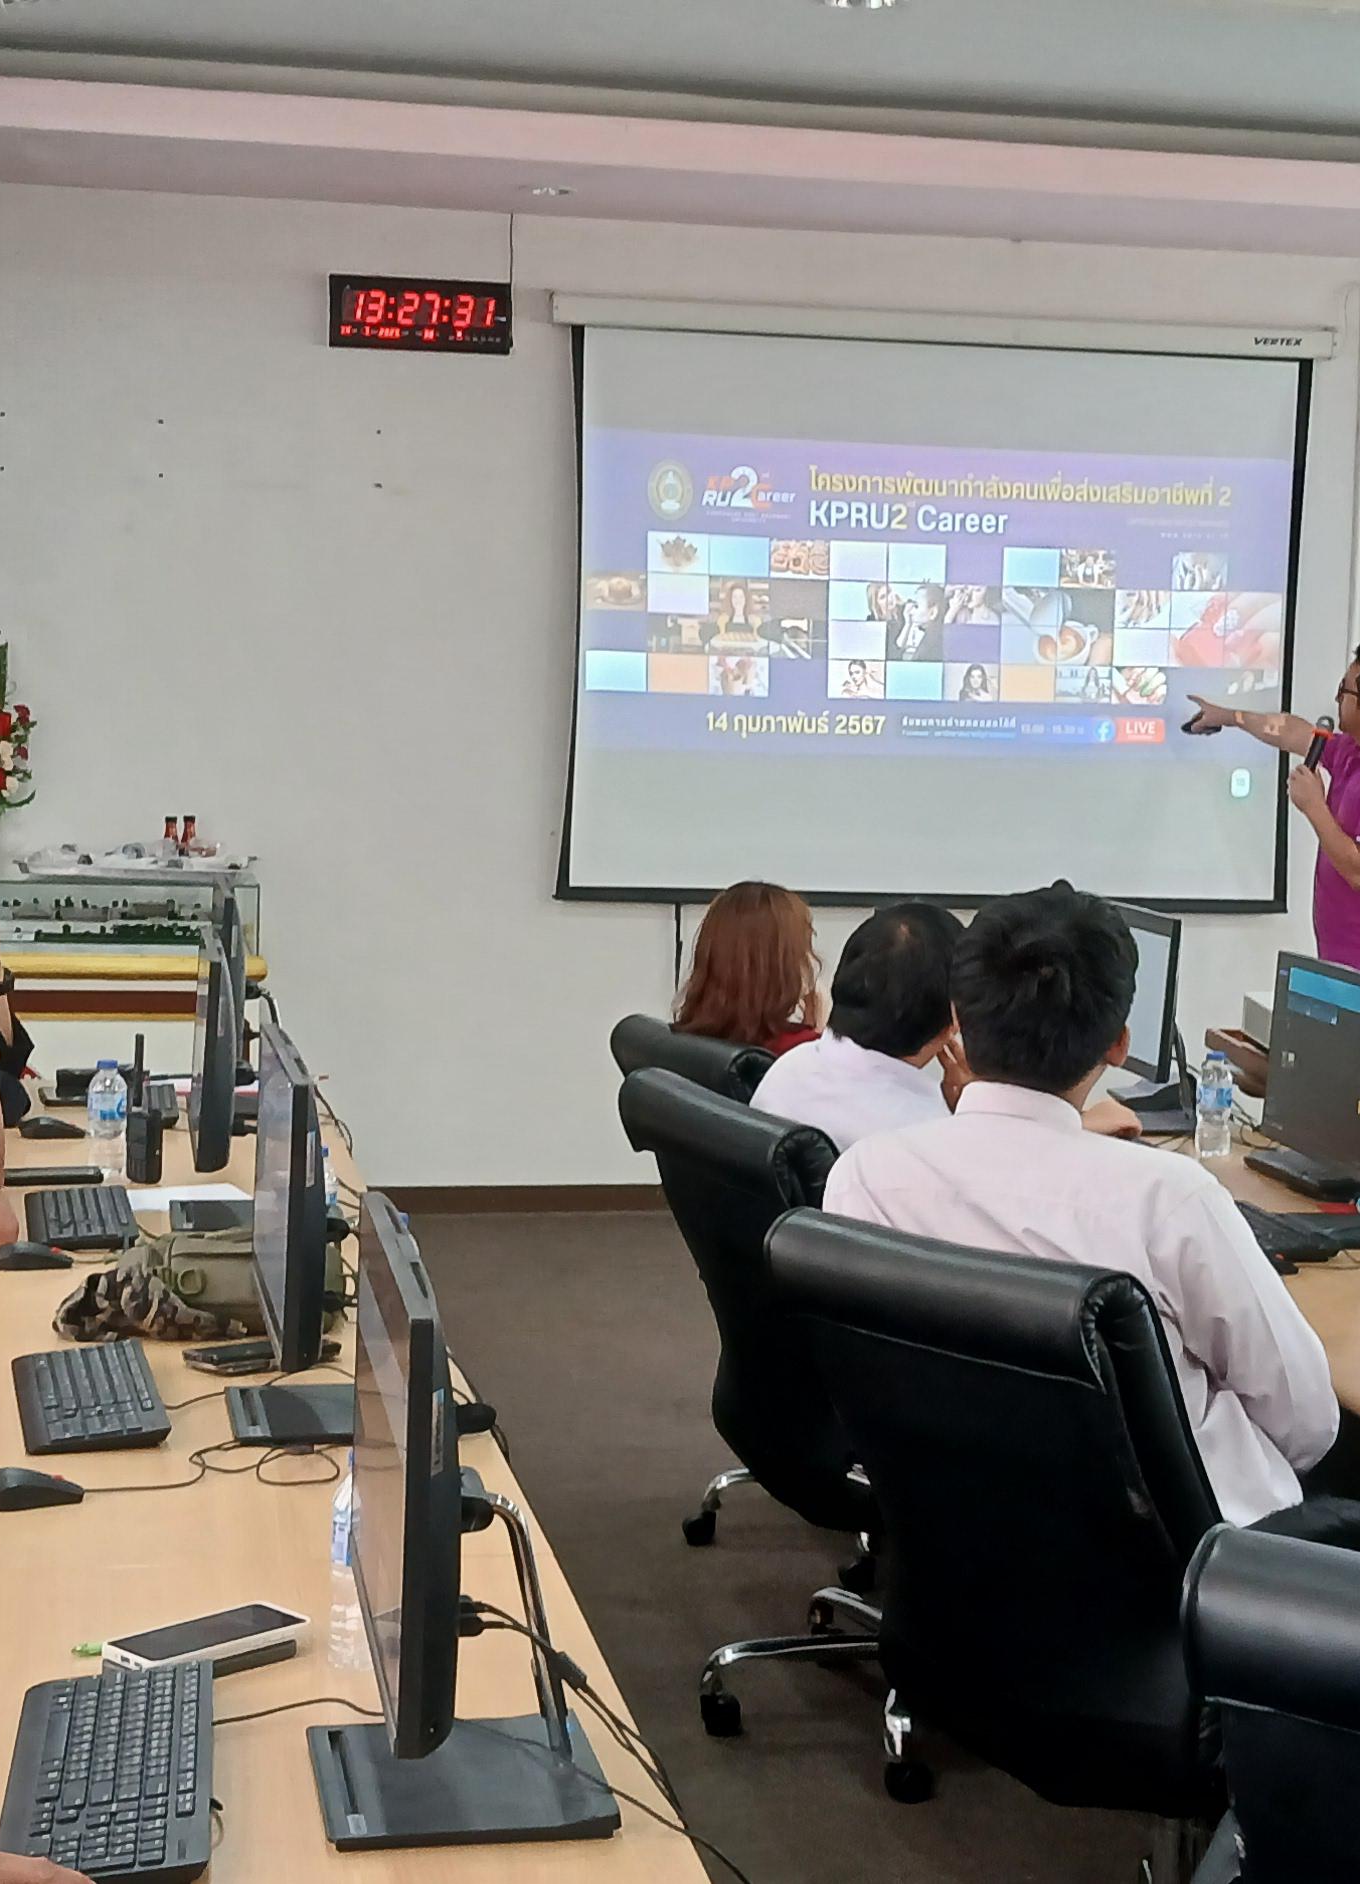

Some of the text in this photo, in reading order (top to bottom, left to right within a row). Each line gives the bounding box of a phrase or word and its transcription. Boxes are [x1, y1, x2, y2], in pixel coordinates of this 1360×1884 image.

[354, 289, 497, 328] 13:27:31
[1254, 337, 1302, 346] VERTEX
[1218, 486, 1232, 507] 2
[917, 504, 1008, 534] Career
[706, 711, 728, 732] 14
[734, 710, 830, 738] กุมภาพันธ์
[834, 715, 887, 735] 2567
[1126, 720, 1156, 735] LIVE
